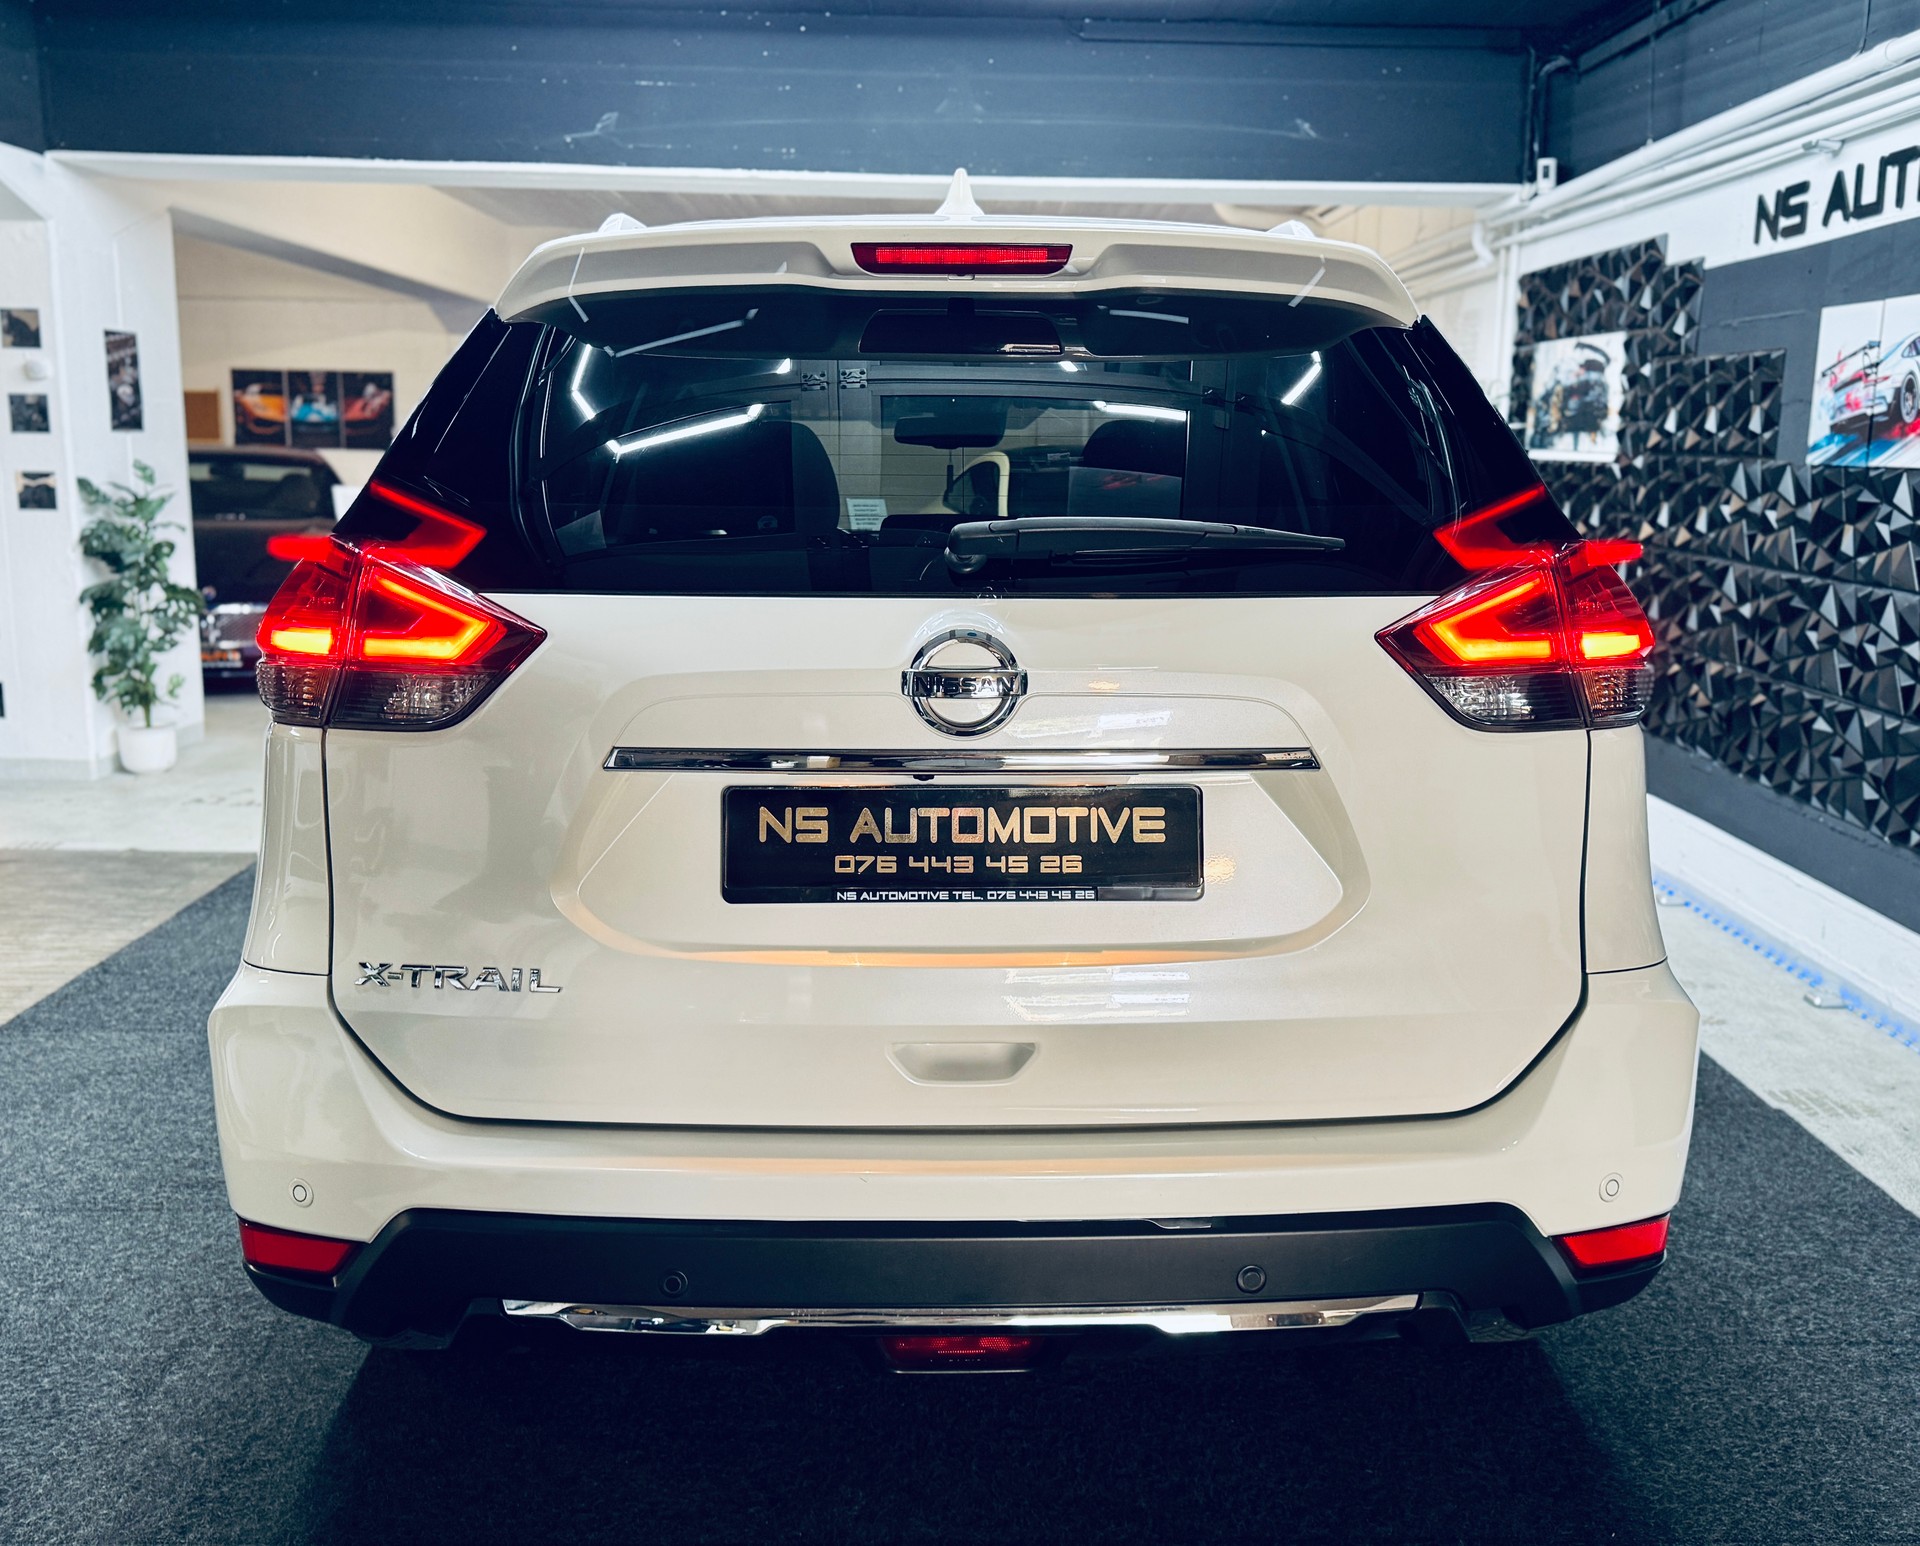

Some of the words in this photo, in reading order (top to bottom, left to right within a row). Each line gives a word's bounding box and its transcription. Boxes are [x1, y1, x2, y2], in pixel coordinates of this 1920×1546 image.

[1754, 180, 1810, 244] NS
[1822, 145, 1920, 227] AUT
[914, 676, 1015, 696] NISSAN
[759, 806, 829, 844] NS
[849, 806, 1166, 844] AUTOMOTIVE
[834, 855, 897, 874] 076
[908, 855, 974, 874] 443
[985, 855, 1029, 874] 45
[1040, 855, 1083, 874] 26
[836, 891, 857, 901] NS
[860, 890, 949, 901] AUTOMOTIVE
[987, 890, 1016, 900] 076
[1019, 890, 1049, 900] 443
[1051, 890, 1072, 900] 45
[1075, 890, 1096, 900] 26
[354, 961, 562, 993] X-TRAIL
